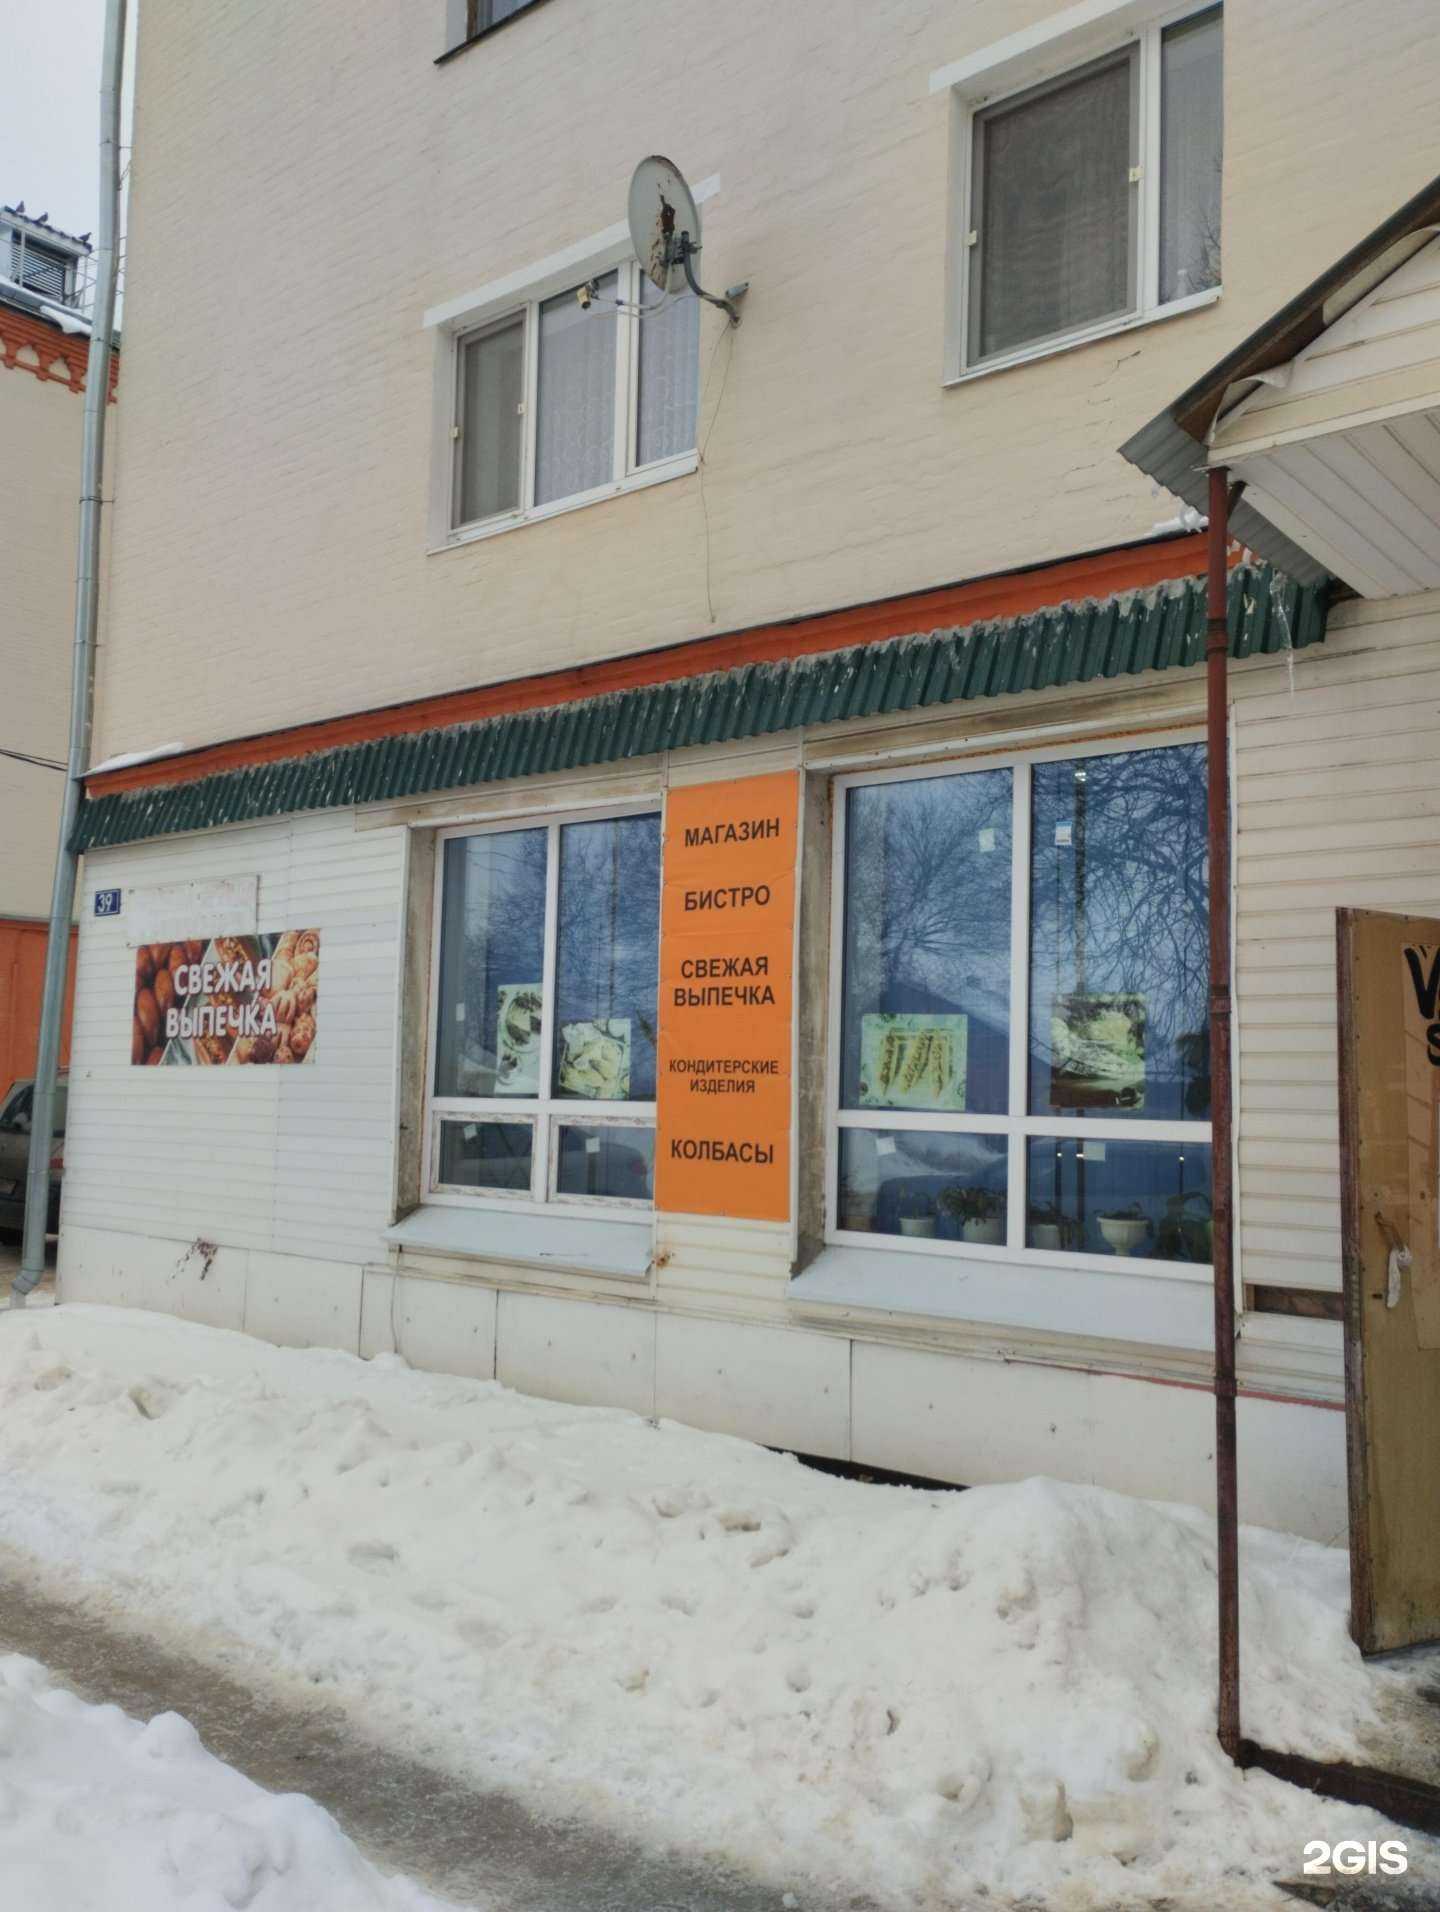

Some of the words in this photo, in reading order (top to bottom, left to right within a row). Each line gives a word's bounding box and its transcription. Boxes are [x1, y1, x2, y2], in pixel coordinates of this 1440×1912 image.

[684, 817, 780, 847] МАГАЗИН
[98, 894, 112, 911] 39
[684, 885, 770, 911] БИСТРО
[174, 959, 272, 995] СВЕЖАЯ
[681, 956, 769, 979] СВЕЖАЯ
[674, 985, 776, 1006] ВЫПЕЧКА
[166, 1003, 277, 1037] ВЫПЕЧКА
[669, 1059, 779, 1075] КОНДИТЕРСКИЕ
[689, 1079, 756, 1095] ИЗДЕЛИЯ
[671, 1139, 774, 1164] КОЛБАСЫ
